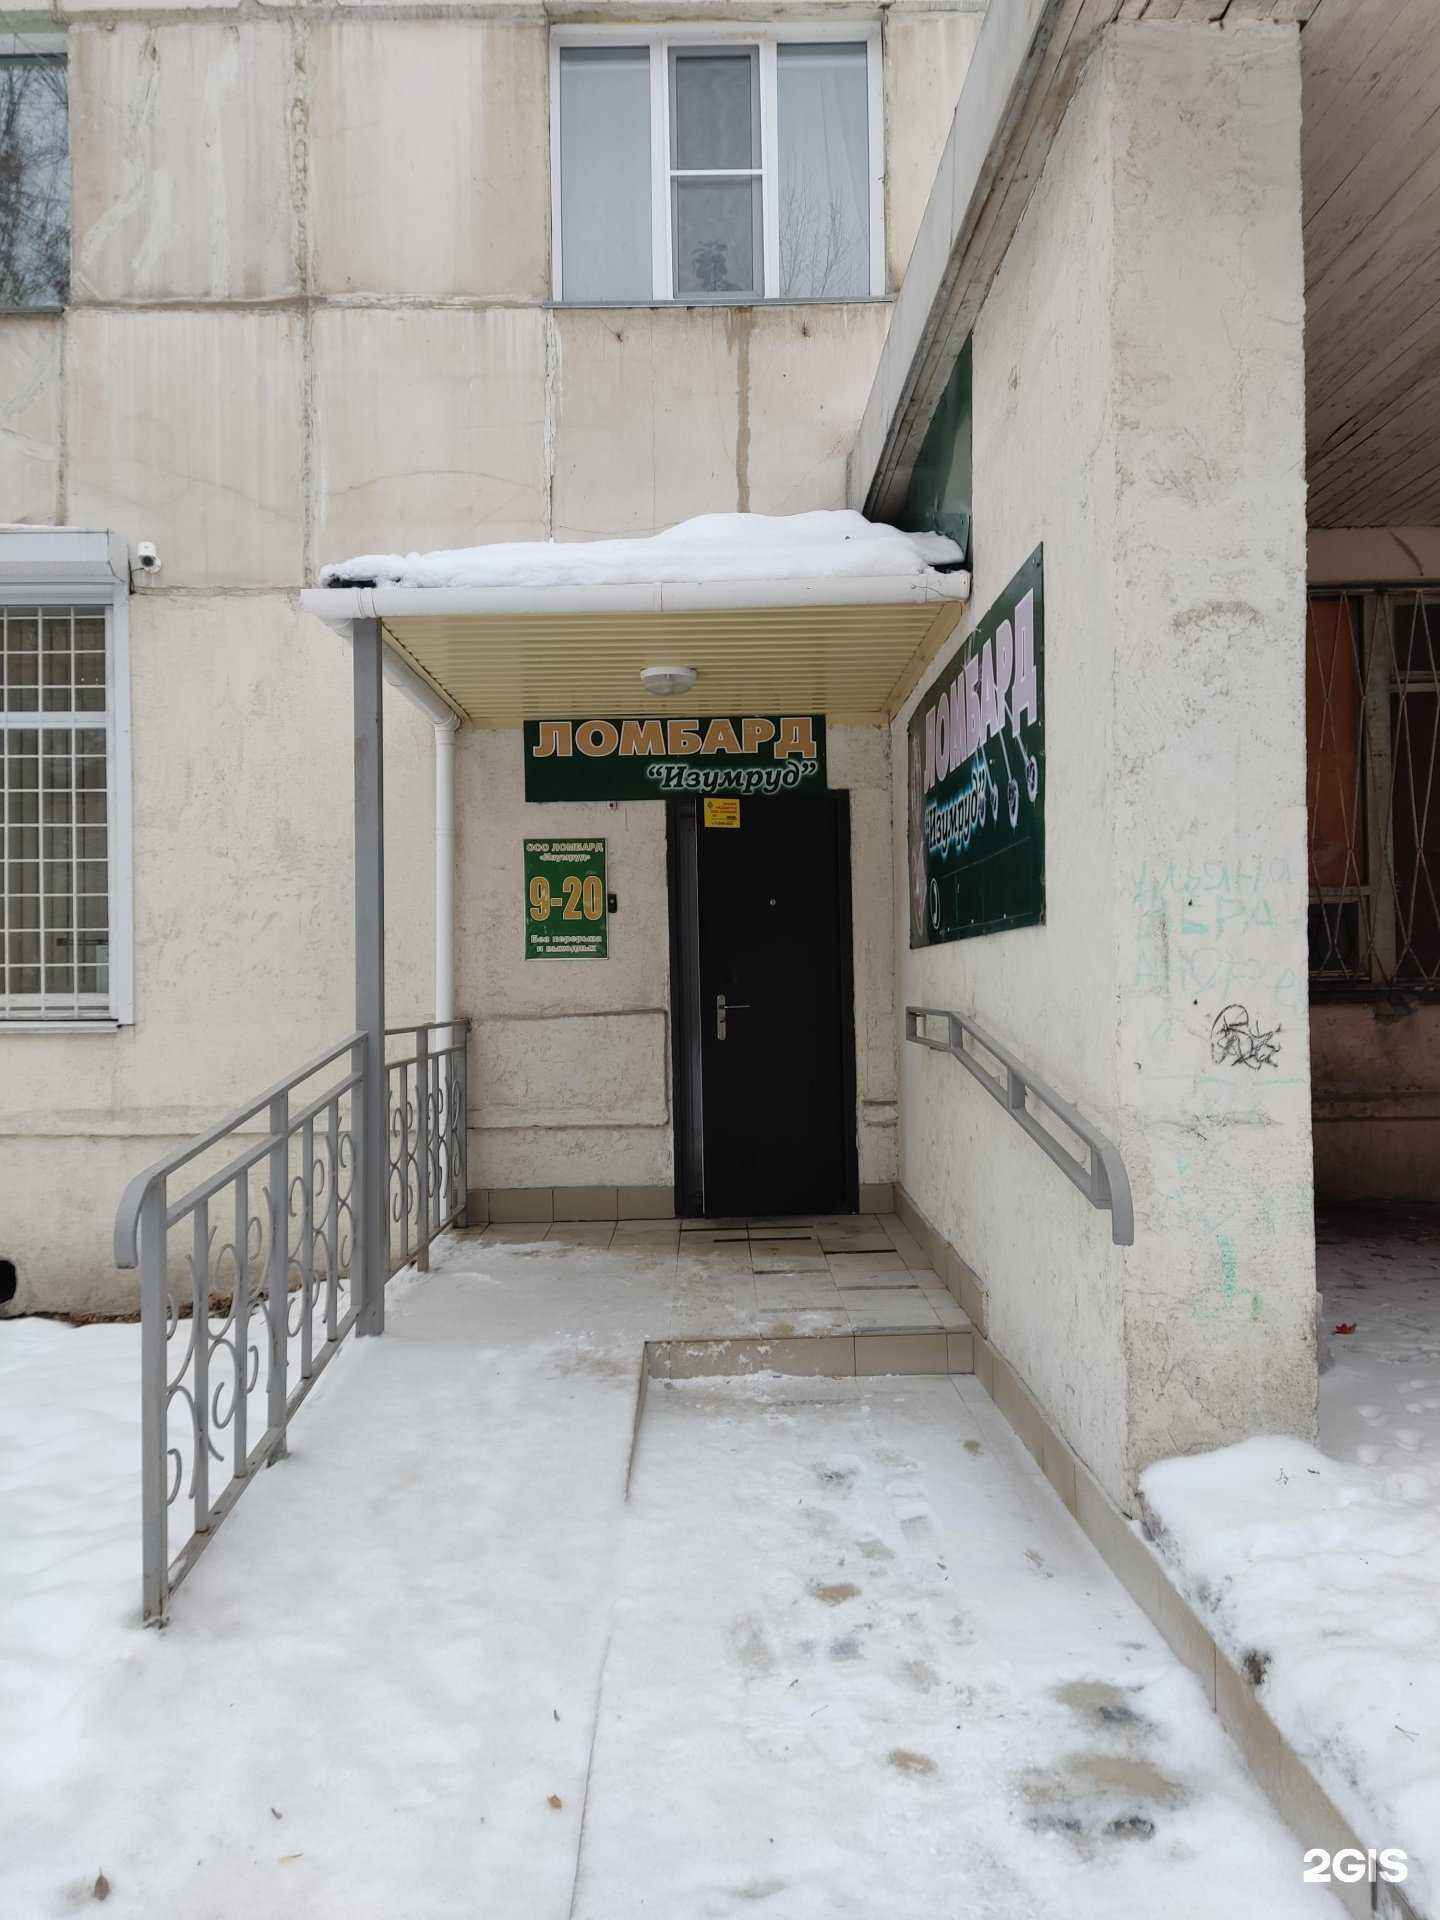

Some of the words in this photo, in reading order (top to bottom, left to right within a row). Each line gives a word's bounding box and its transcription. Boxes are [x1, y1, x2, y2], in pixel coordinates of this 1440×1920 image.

[923, 588, 1038, 795] ЛОМБАРД
[533, 717, 817, 758] ЛОМБАРД
[530, 875, 603, 922] 9-20
